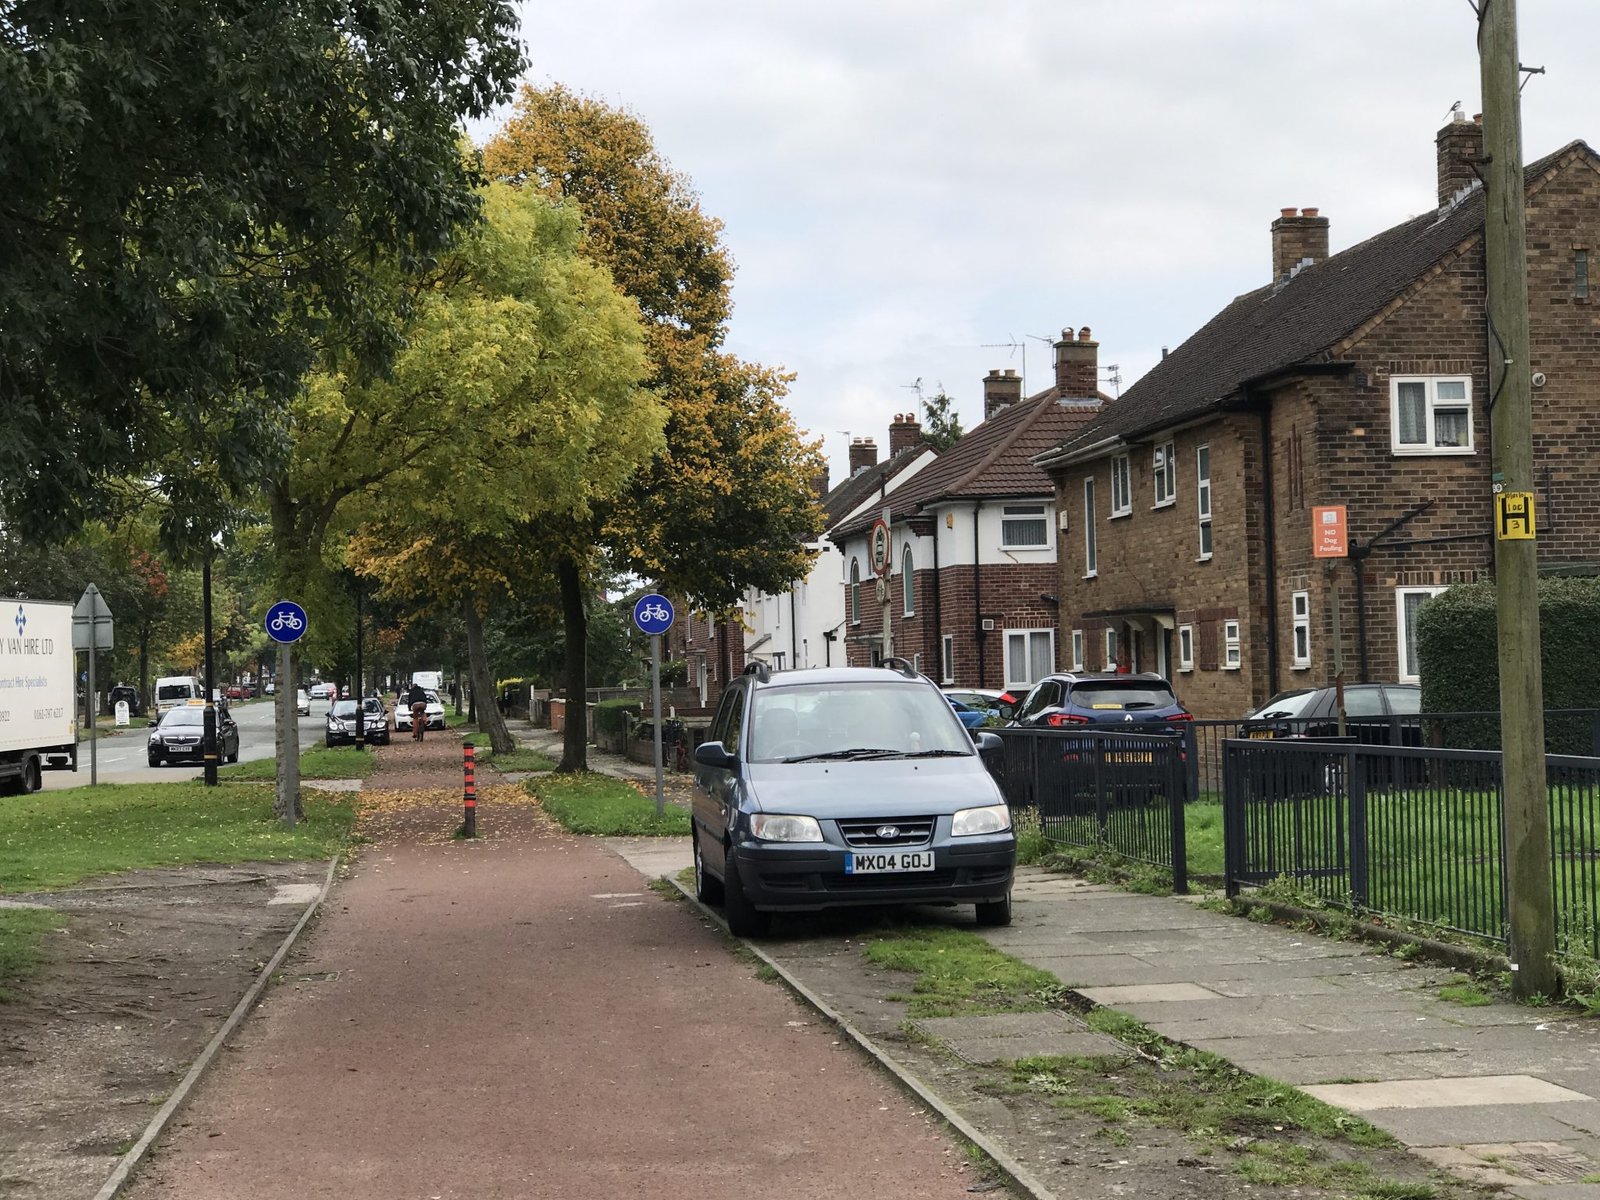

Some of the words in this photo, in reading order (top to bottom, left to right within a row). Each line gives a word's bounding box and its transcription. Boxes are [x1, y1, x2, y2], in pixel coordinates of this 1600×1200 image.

[1501, 496, 1530, 535] H
[1508, 503, 1523, 512] 100
[1512, 520, 1520, 529] 3
[7, 638, 22, 655] VAN
[24, 638, 40, 655] HIRE
[41, 638, 54, 655] LTD
[855, 854, 897, 871] MX04
[901, 853, 932, 869] GOJ
